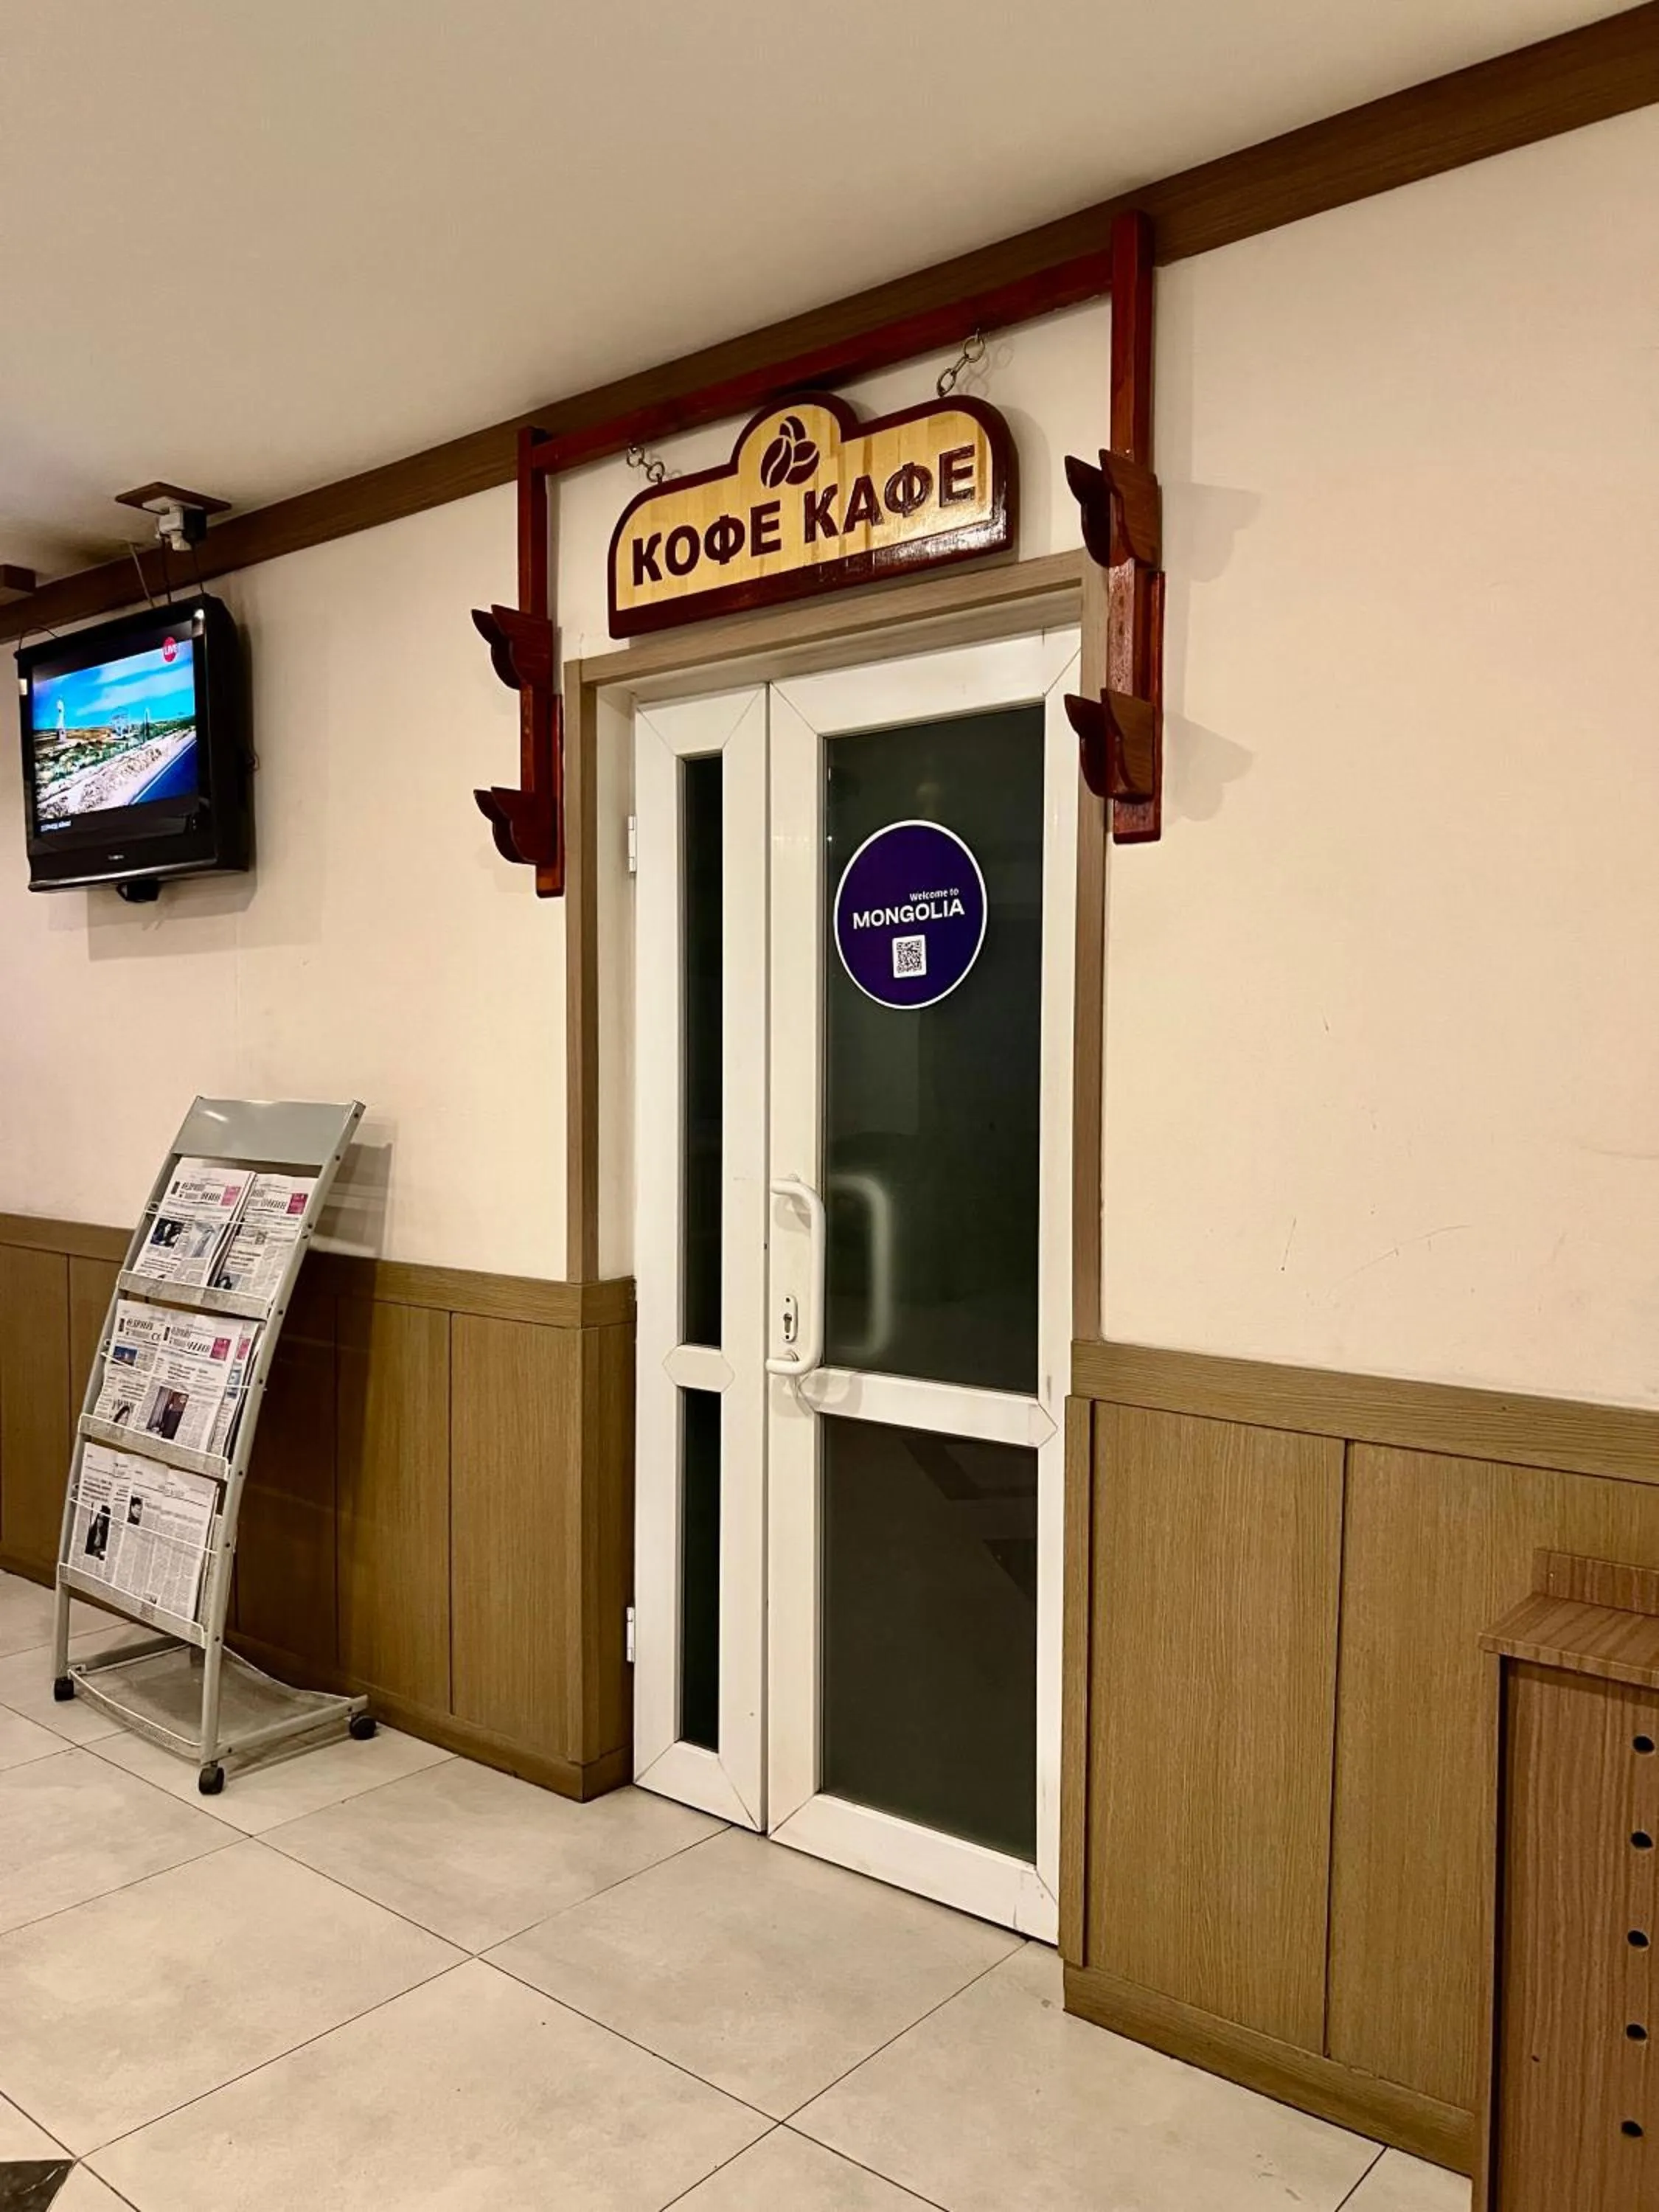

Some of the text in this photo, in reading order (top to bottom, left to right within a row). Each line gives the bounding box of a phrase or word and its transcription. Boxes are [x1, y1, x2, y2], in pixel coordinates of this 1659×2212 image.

[632, 445, 975, 586] КОФЕ КАФЕ
[163, 644, 178, 655] LIVE
[909, 888, 959, 901] Welcome to
[852, 898, 965, 929] MONGOLIA
